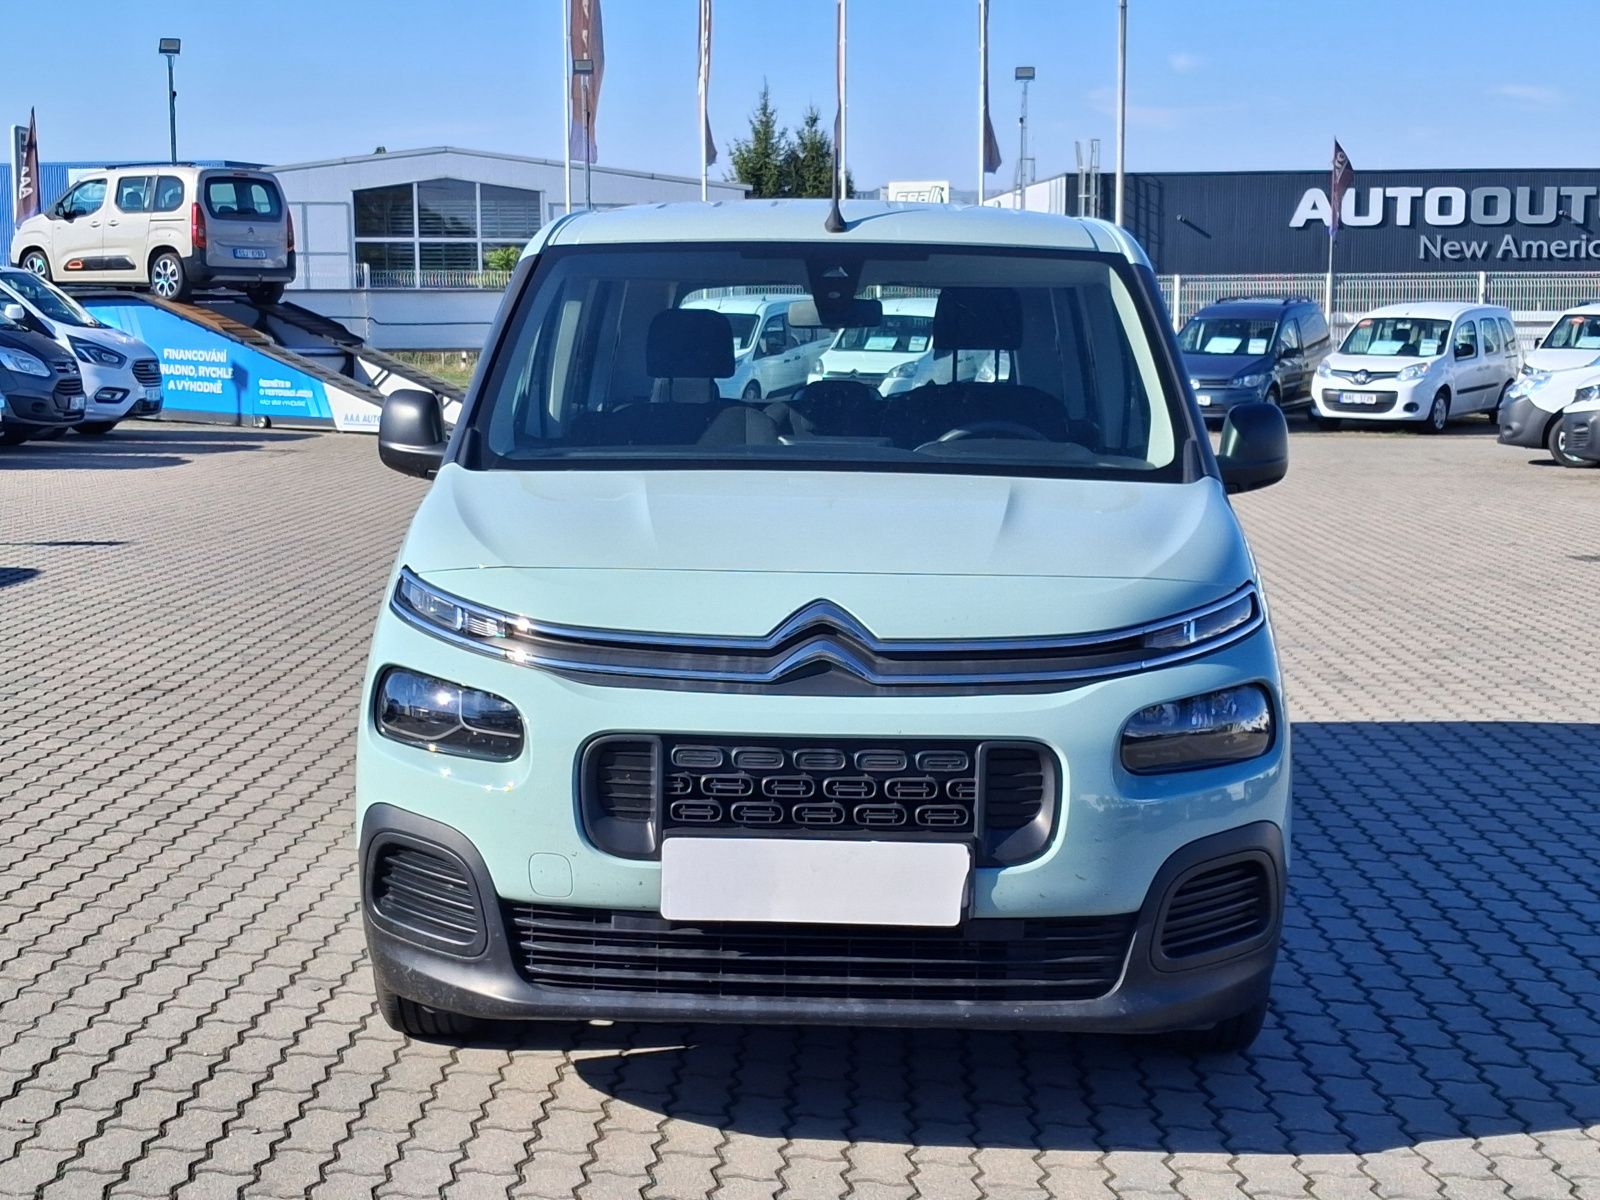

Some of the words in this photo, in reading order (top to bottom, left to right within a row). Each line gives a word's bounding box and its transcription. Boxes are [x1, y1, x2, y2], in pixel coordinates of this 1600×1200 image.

[1289, 186, 1600, 227] AUTOOUT
[1420, 235, 1488, 260] New
[163, 348, 227, 363] FINANCOVÁNÍ
[160, 363, 198, 378] NADNO,
[198, 365, 234, 379] RYCHLE
[168, 380, 175, 390] A
[176, 378, 223, 394] VÝHODNĚ
[344, 413, 360, 423] AAA
